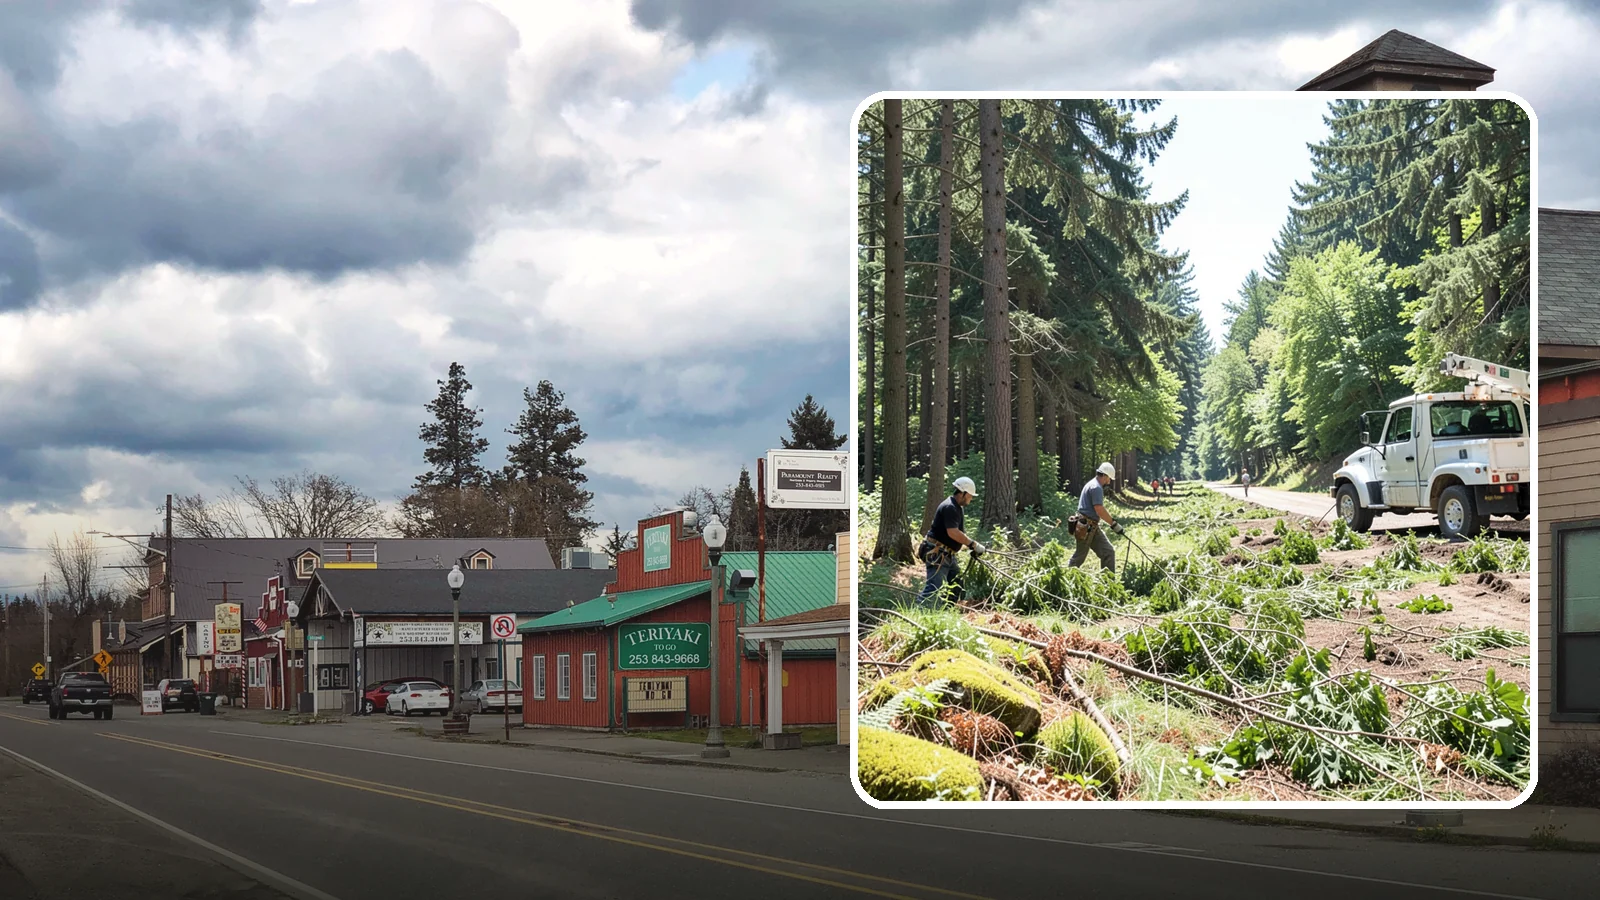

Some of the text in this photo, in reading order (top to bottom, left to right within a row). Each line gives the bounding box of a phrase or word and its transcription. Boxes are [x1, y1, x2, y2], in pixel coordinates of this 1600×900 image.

[781, 471, 839, 480] PARAMOUNT REALTY
[624, 627, 703, 646] TERIYAKI
[654, 643, 677, 651] TO GO
[628, 653, 700, 665] 253 843-9668
